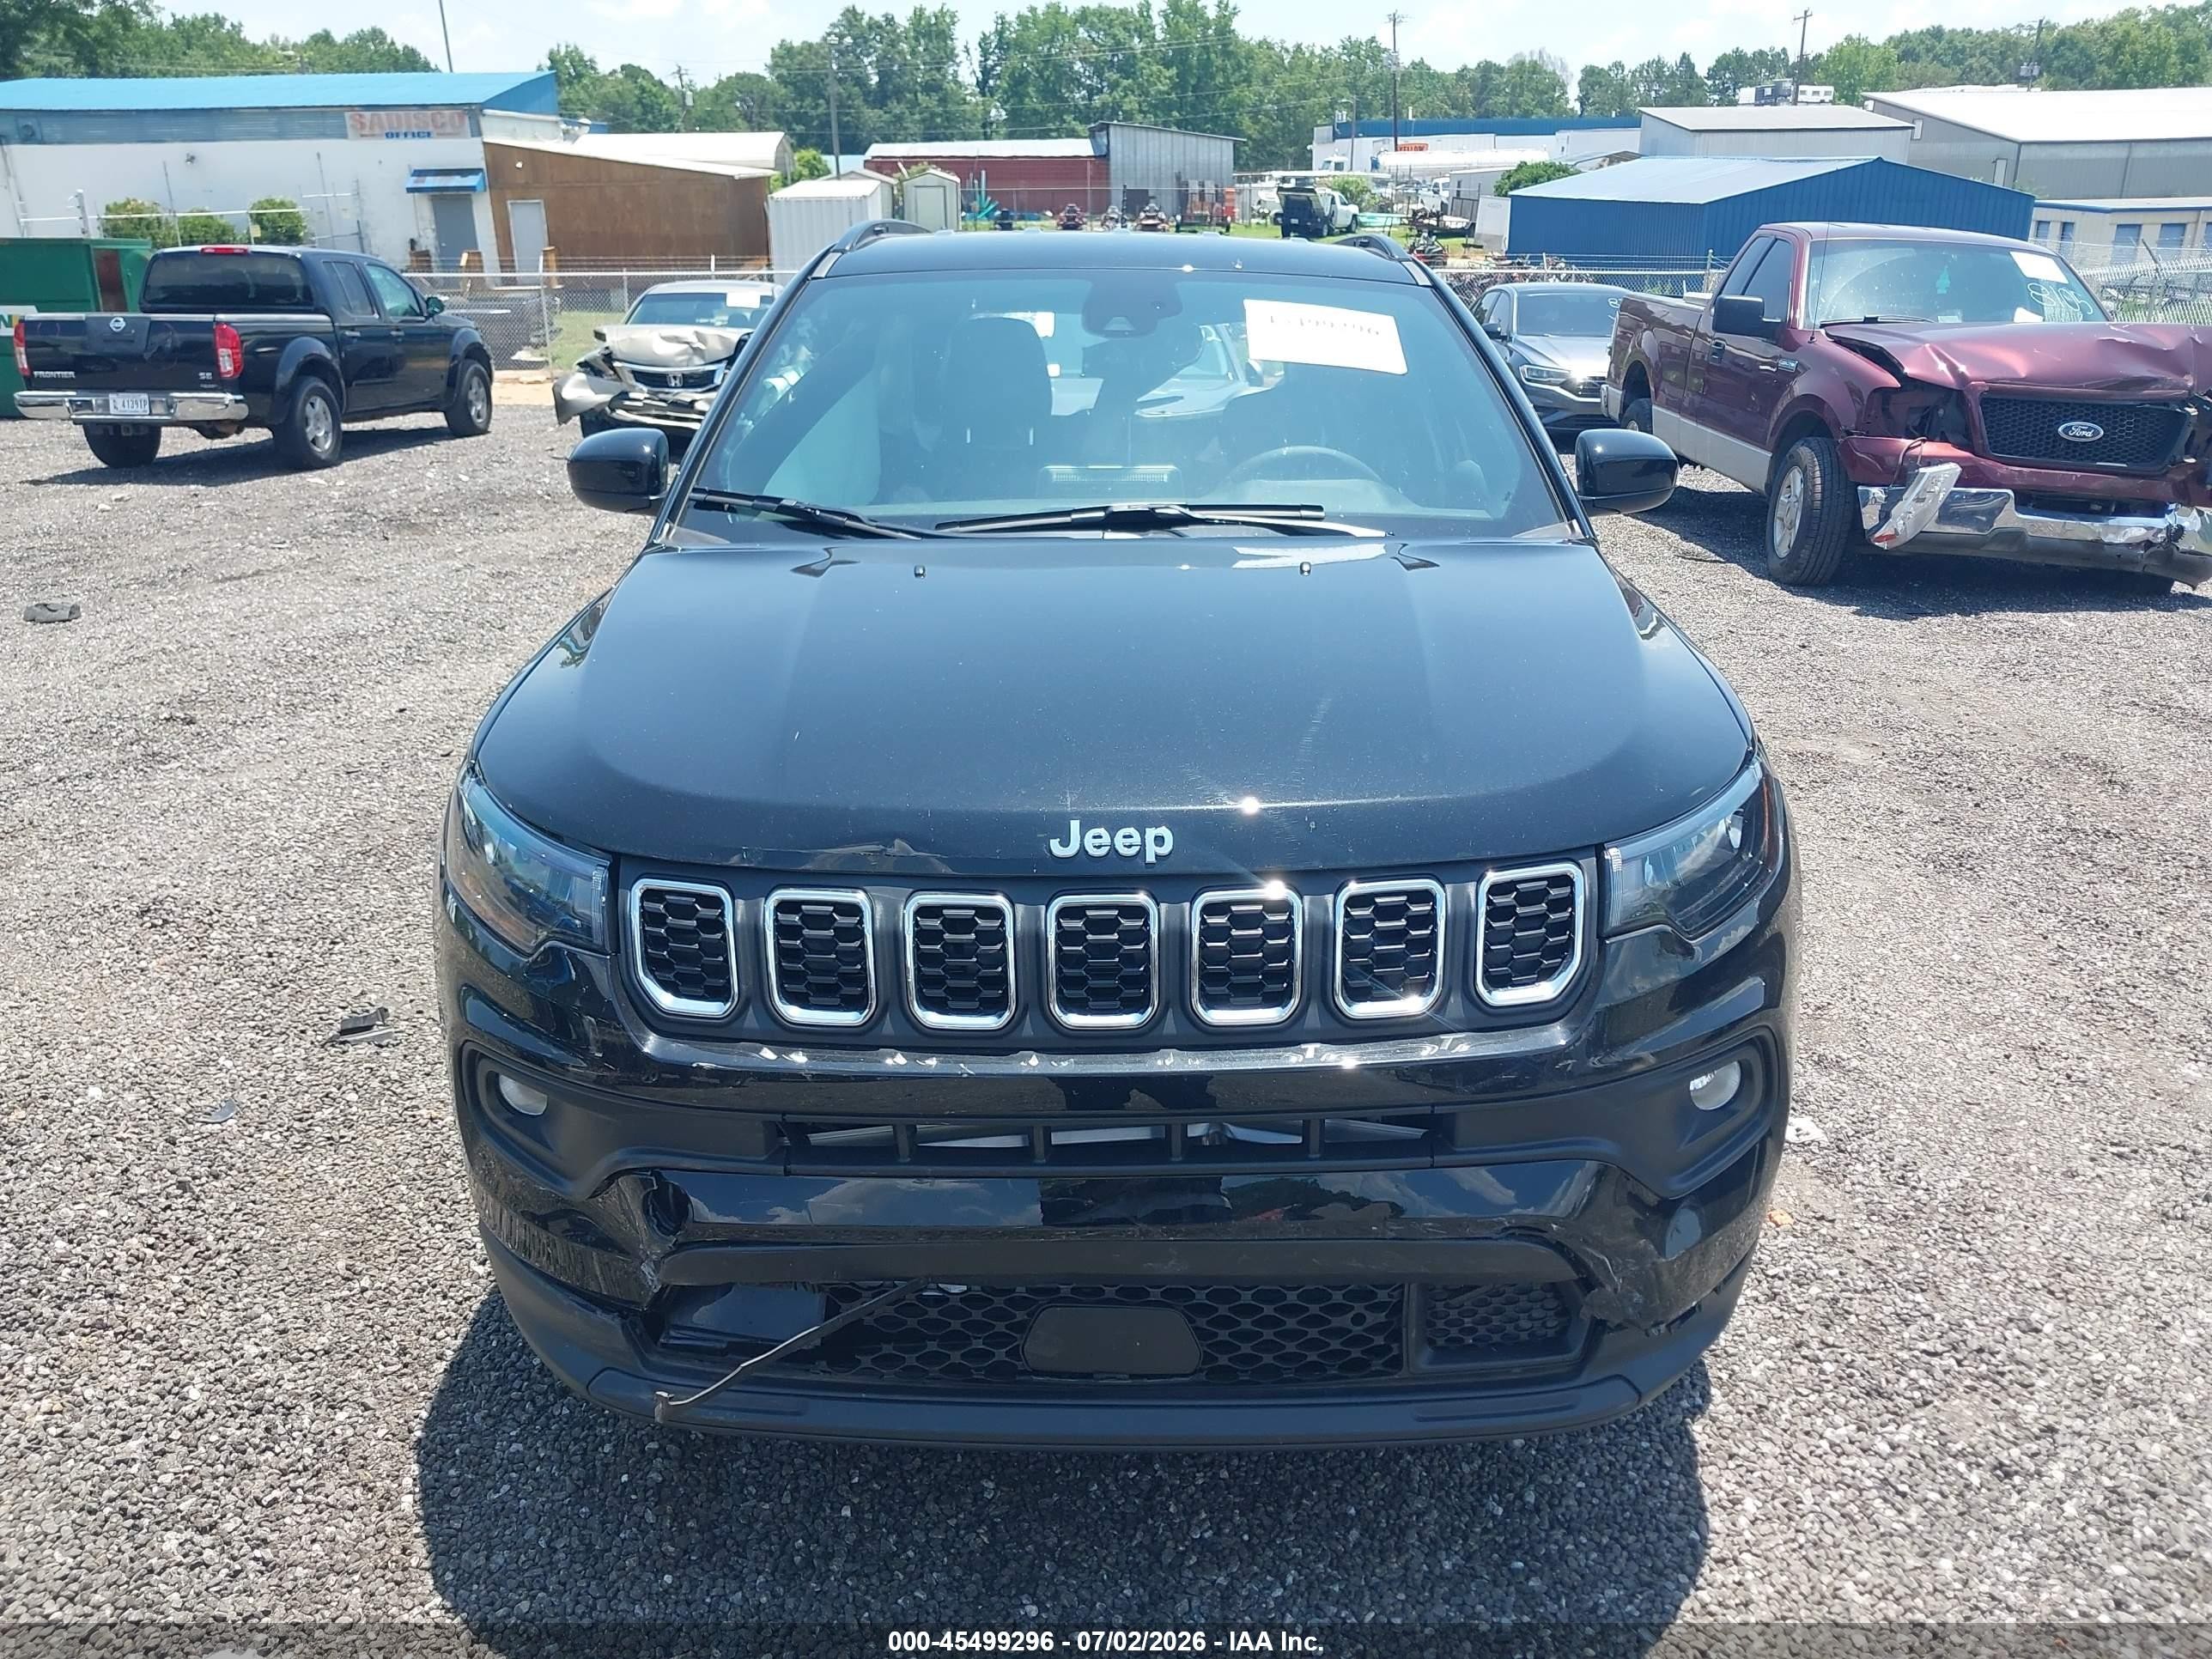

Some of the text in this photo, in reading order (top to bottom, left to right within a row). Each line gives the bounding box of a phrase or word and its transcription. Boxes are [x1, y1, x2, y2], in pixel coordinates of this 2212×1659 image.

[349, 112, 466, 131] SADISCO
[385, 131, 434, 139] OFFICE
[2068, 425, 2094, 437] Ford
[1049, 819, 1174, 864] Jeep
